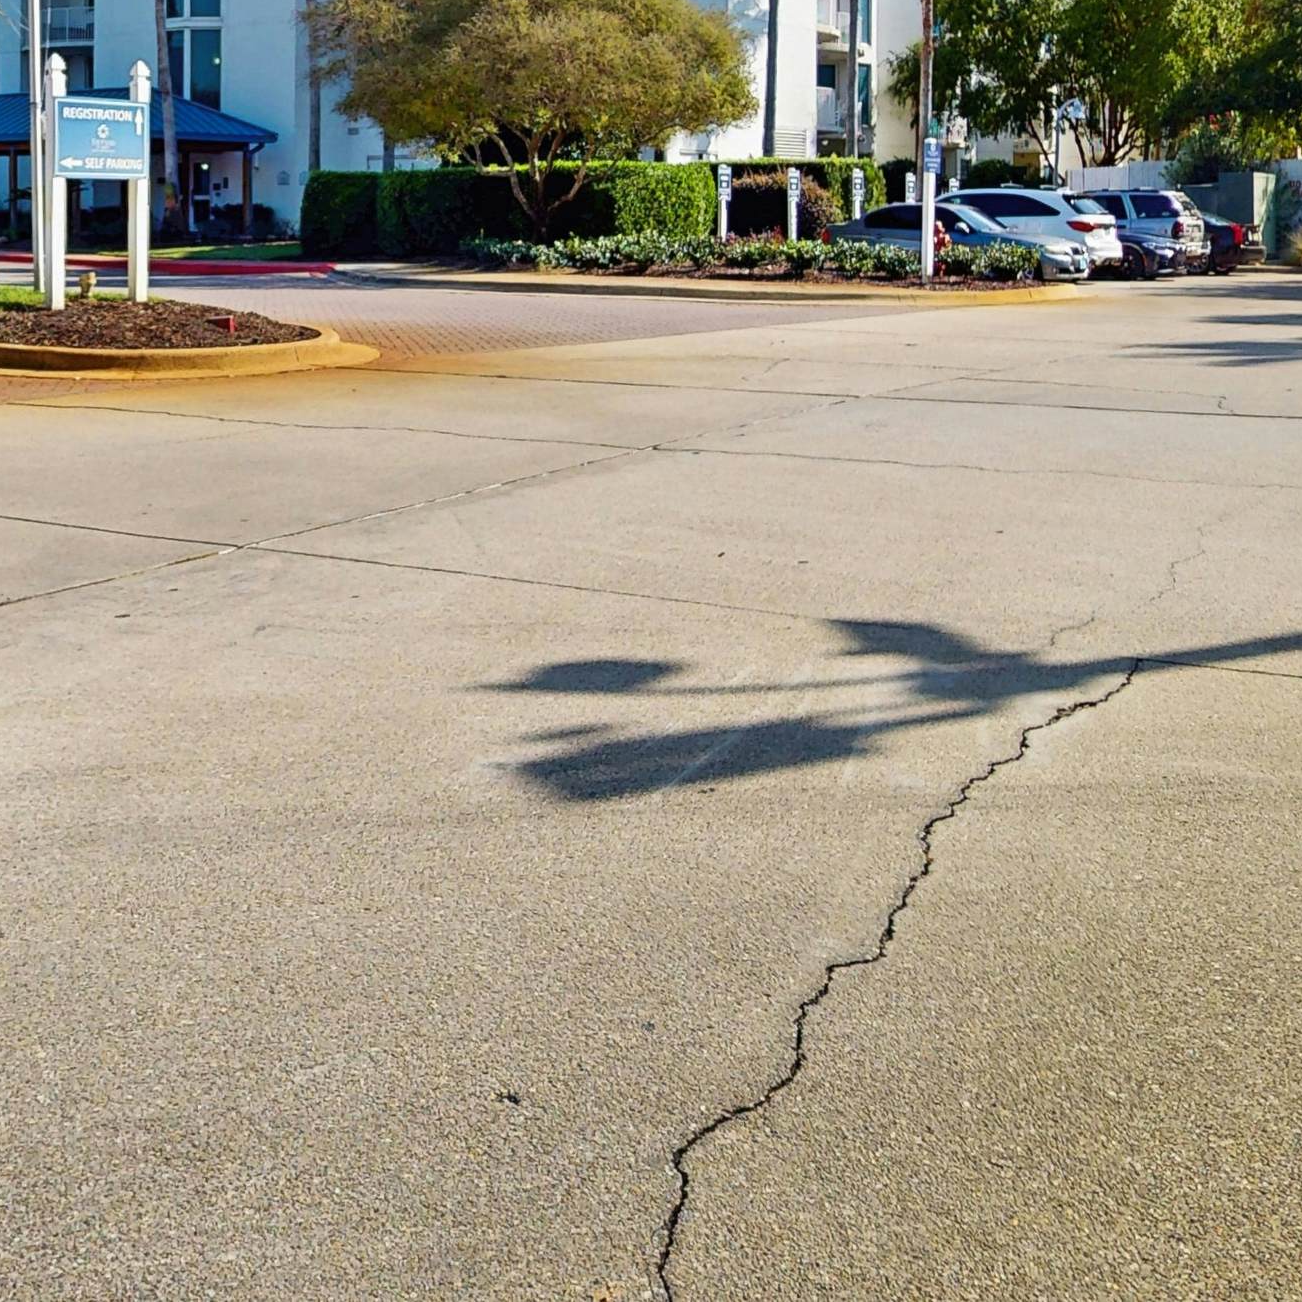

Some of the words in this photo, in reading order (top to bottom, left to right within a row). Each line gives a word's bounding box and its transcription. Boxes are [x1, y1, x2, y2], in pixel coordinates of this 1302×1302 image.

[63, 106, 132, 122] REGISTRATION
[84, 157, 104, 169] SELF
[106, 158, 143, 170] PARKING
